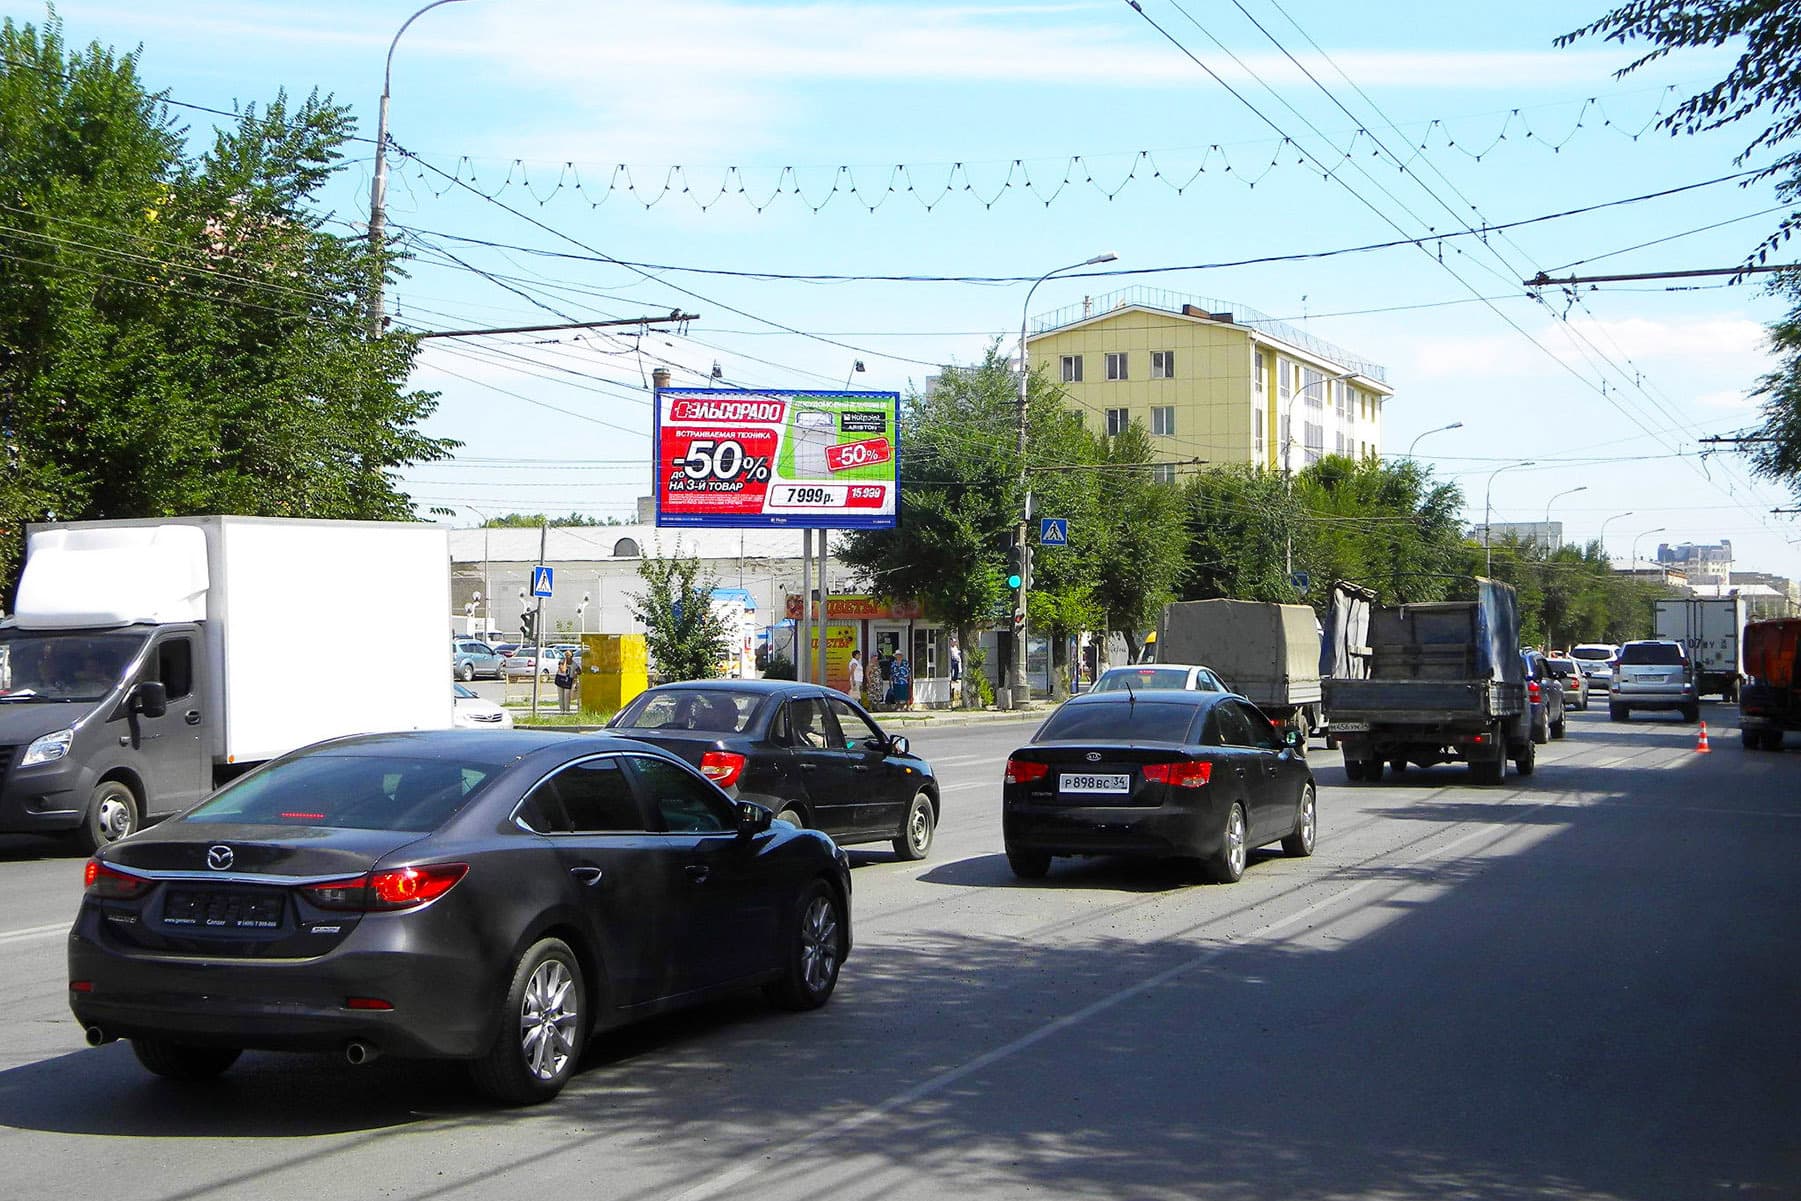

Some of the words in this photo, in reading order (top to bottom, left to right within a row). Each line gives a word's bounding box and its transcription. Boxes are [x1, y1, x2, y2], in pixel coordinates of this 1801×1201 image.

[675, 430, 735, 439] ВСТРАИВАЕМАЯ
[836, 444, 879, 466] -50%
[668, 481, 685, 491] НА
[709, 483, 744, 492] ТОВАР
